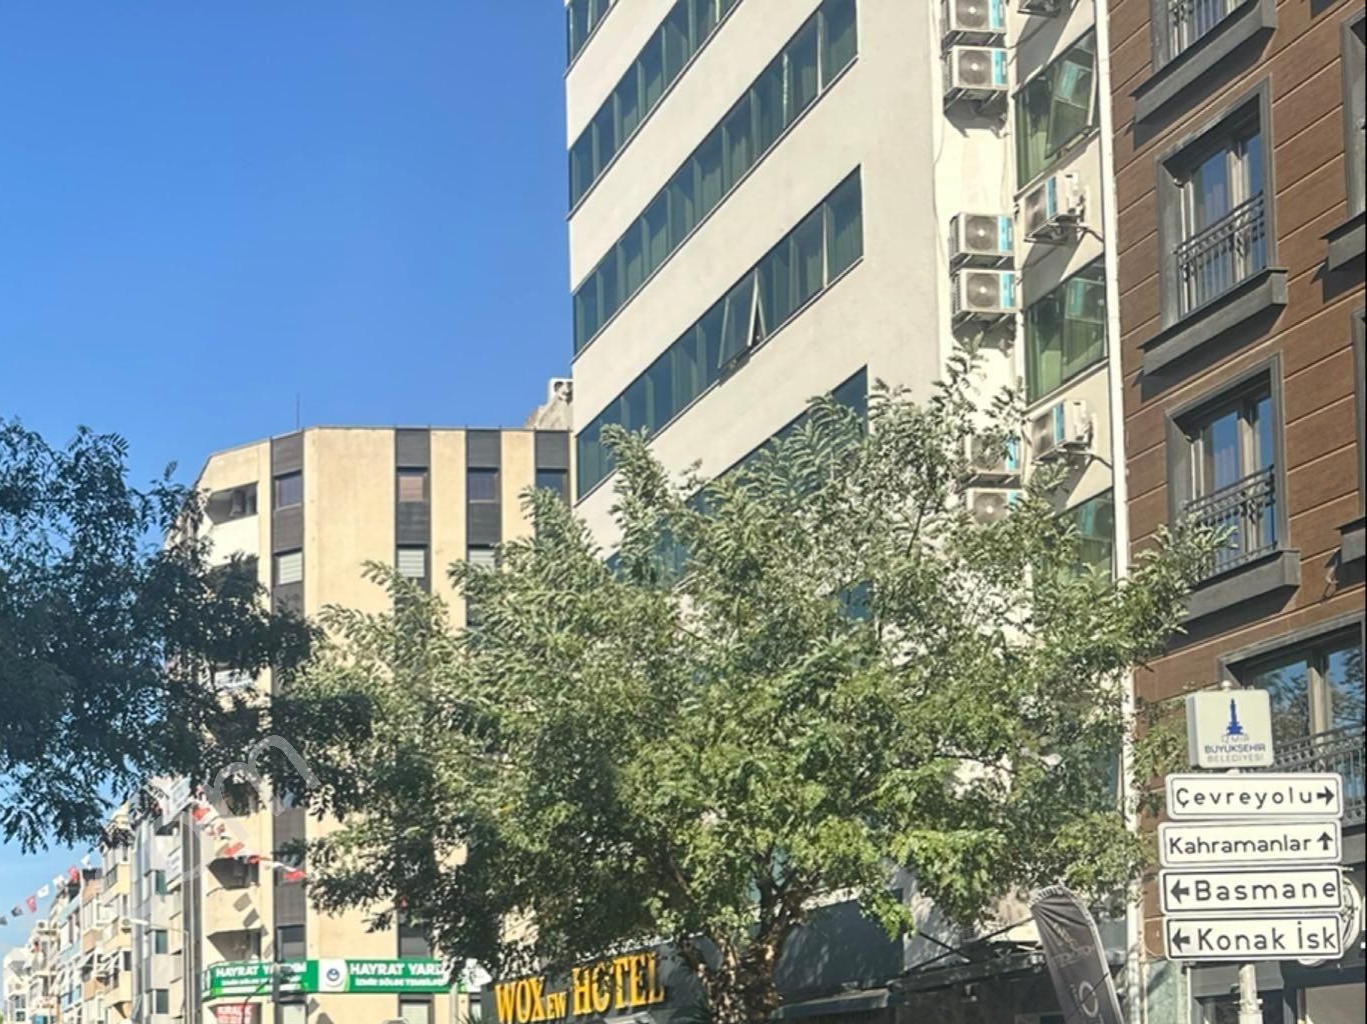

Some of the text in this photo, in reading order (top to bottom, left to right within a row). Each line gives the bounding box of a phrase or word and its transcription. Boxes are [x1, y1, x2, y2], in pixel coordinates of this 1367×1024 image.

[1175, 787, 1312, 809] Çevreyolu
[1169, 834, 1311, 855] Kahramanlar
[1195, 879, 1337, 901] Basmane
[1198, 921, 1337, 951] Konak İsk
[216, 965, 257, 977] HAYRAT
[350, 962, 406, 975] HAYRAT
[571, 951, 665, 1016] HOTEL
